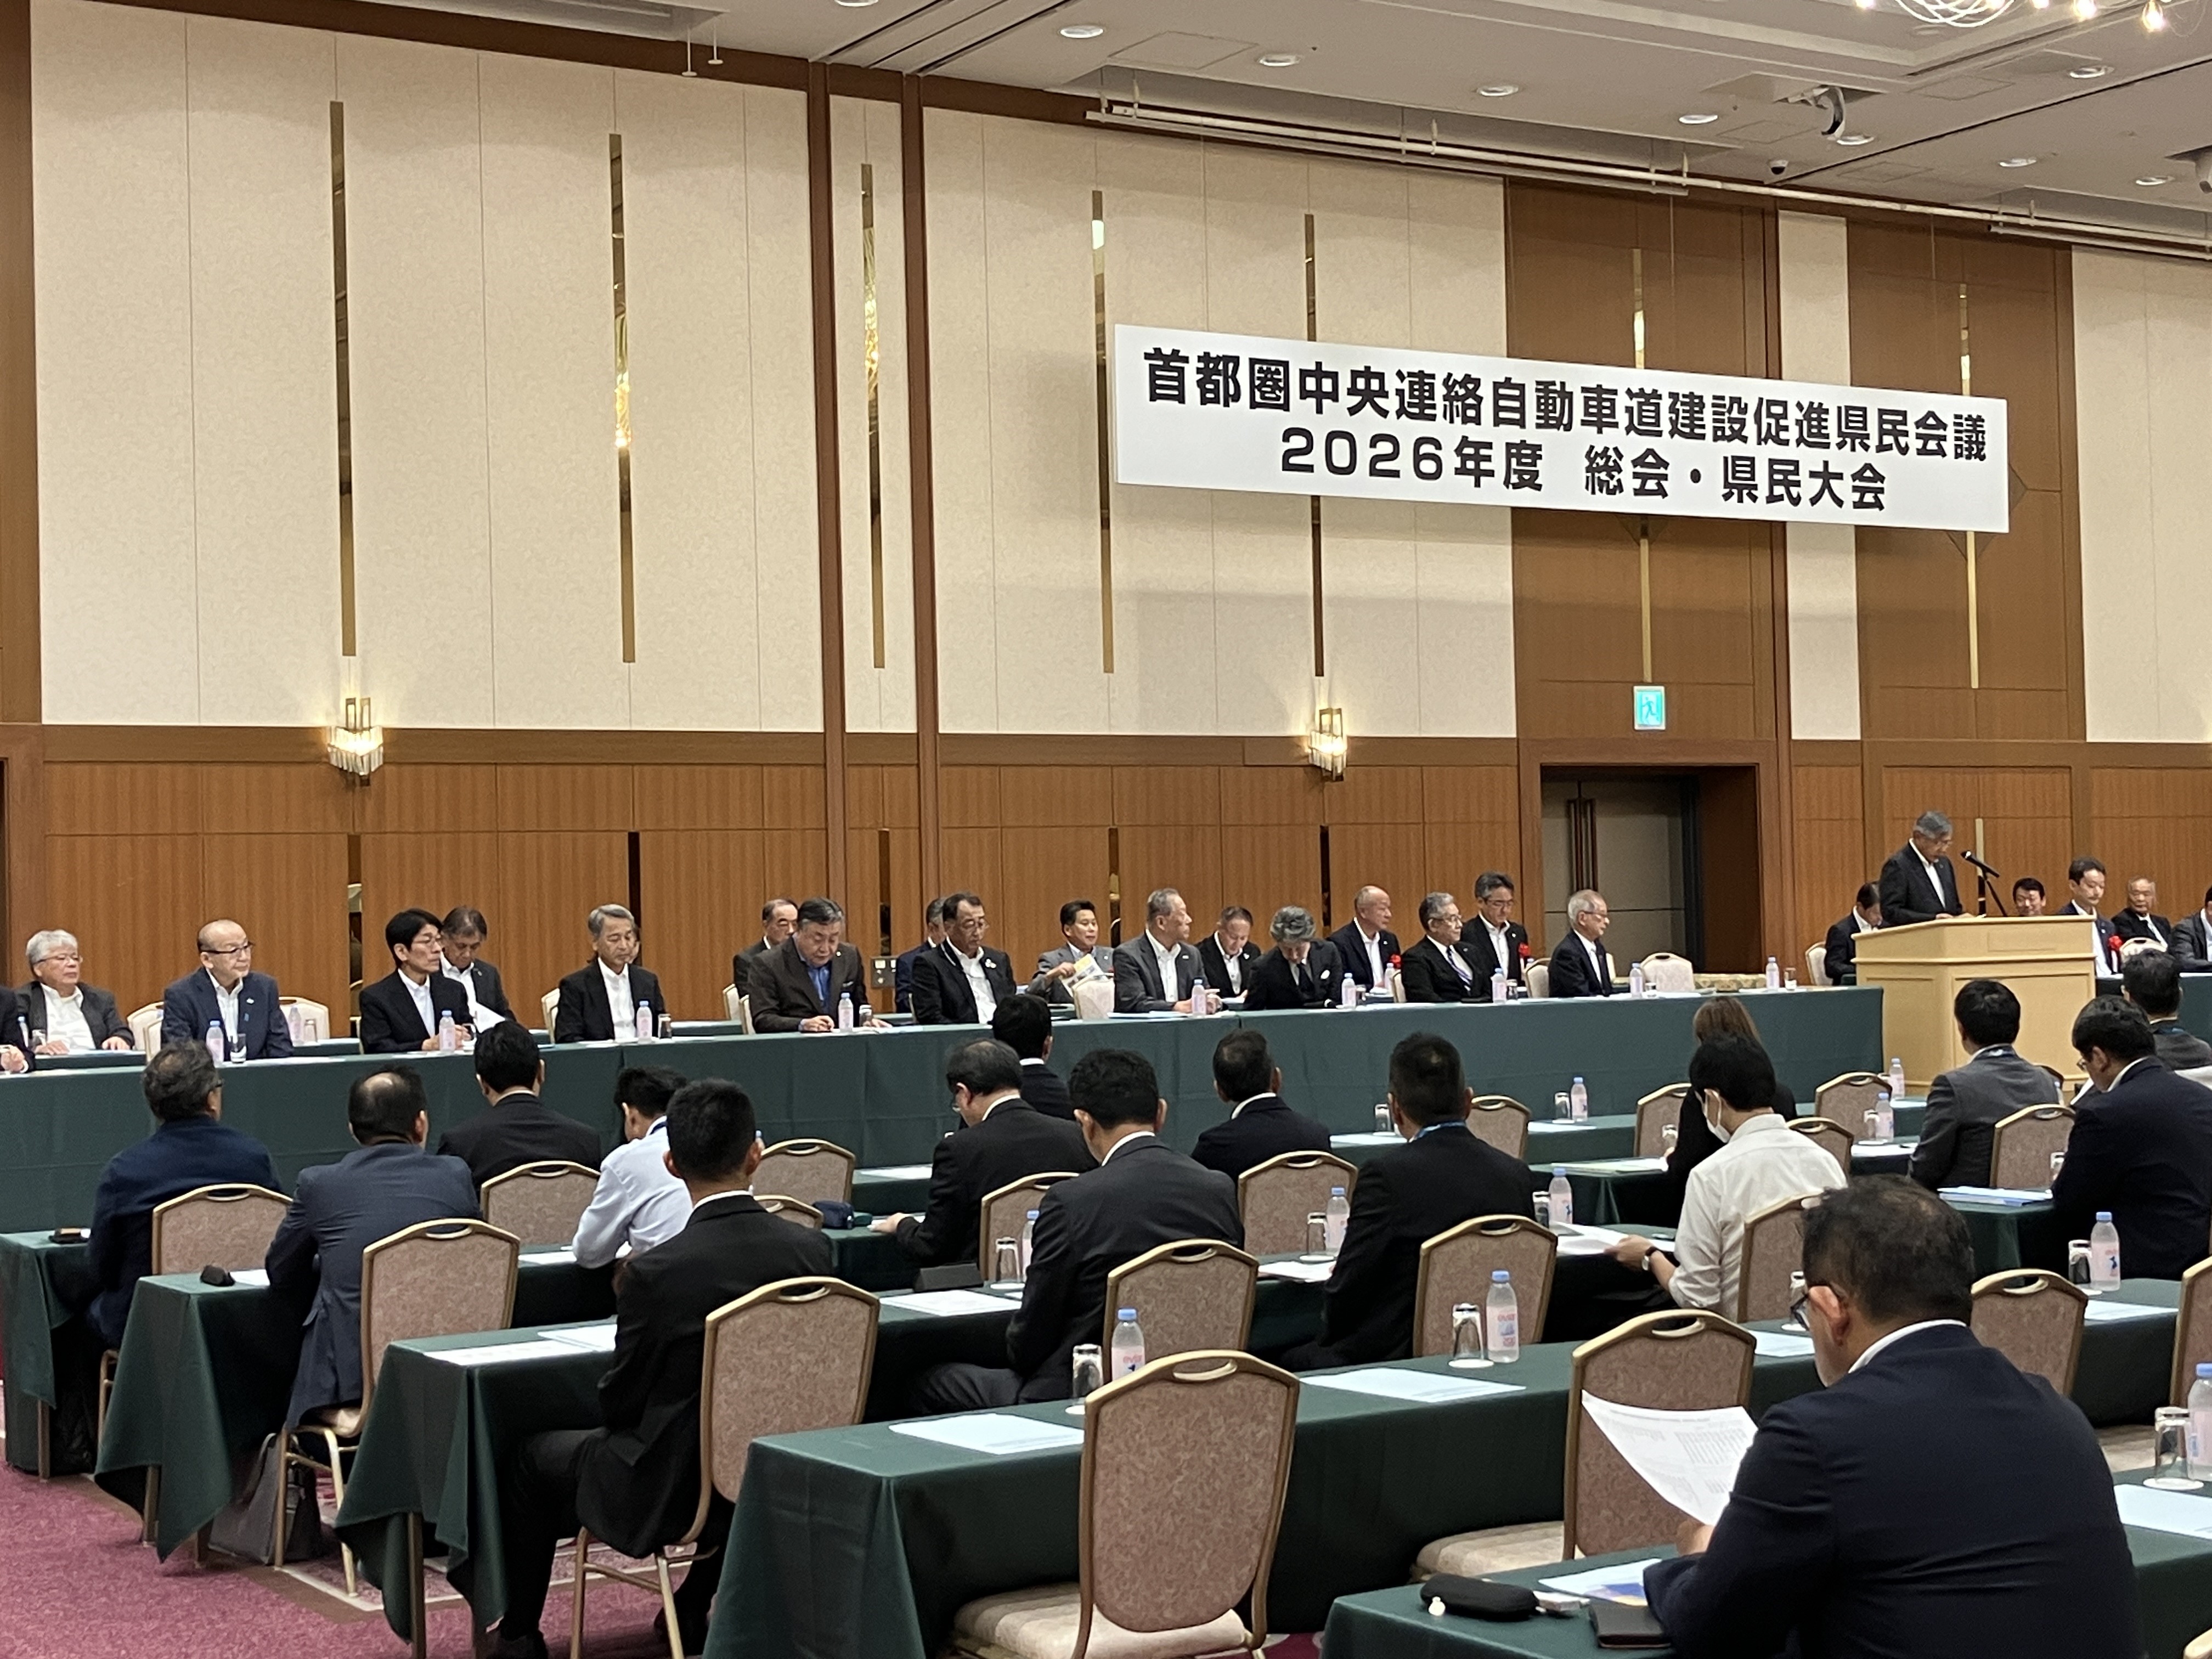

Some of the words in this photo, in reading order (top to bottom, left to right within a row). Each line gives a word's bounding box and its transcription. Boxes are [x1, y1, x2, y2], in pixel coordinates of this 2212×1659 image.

[1143, 347, 1987, 461] 首都圏中央連絡自動車道建設促進県民会議
[1282, 427, 1543, 492] 2026年度
[1584, 444, 1886, 511] 総会・県民大会
